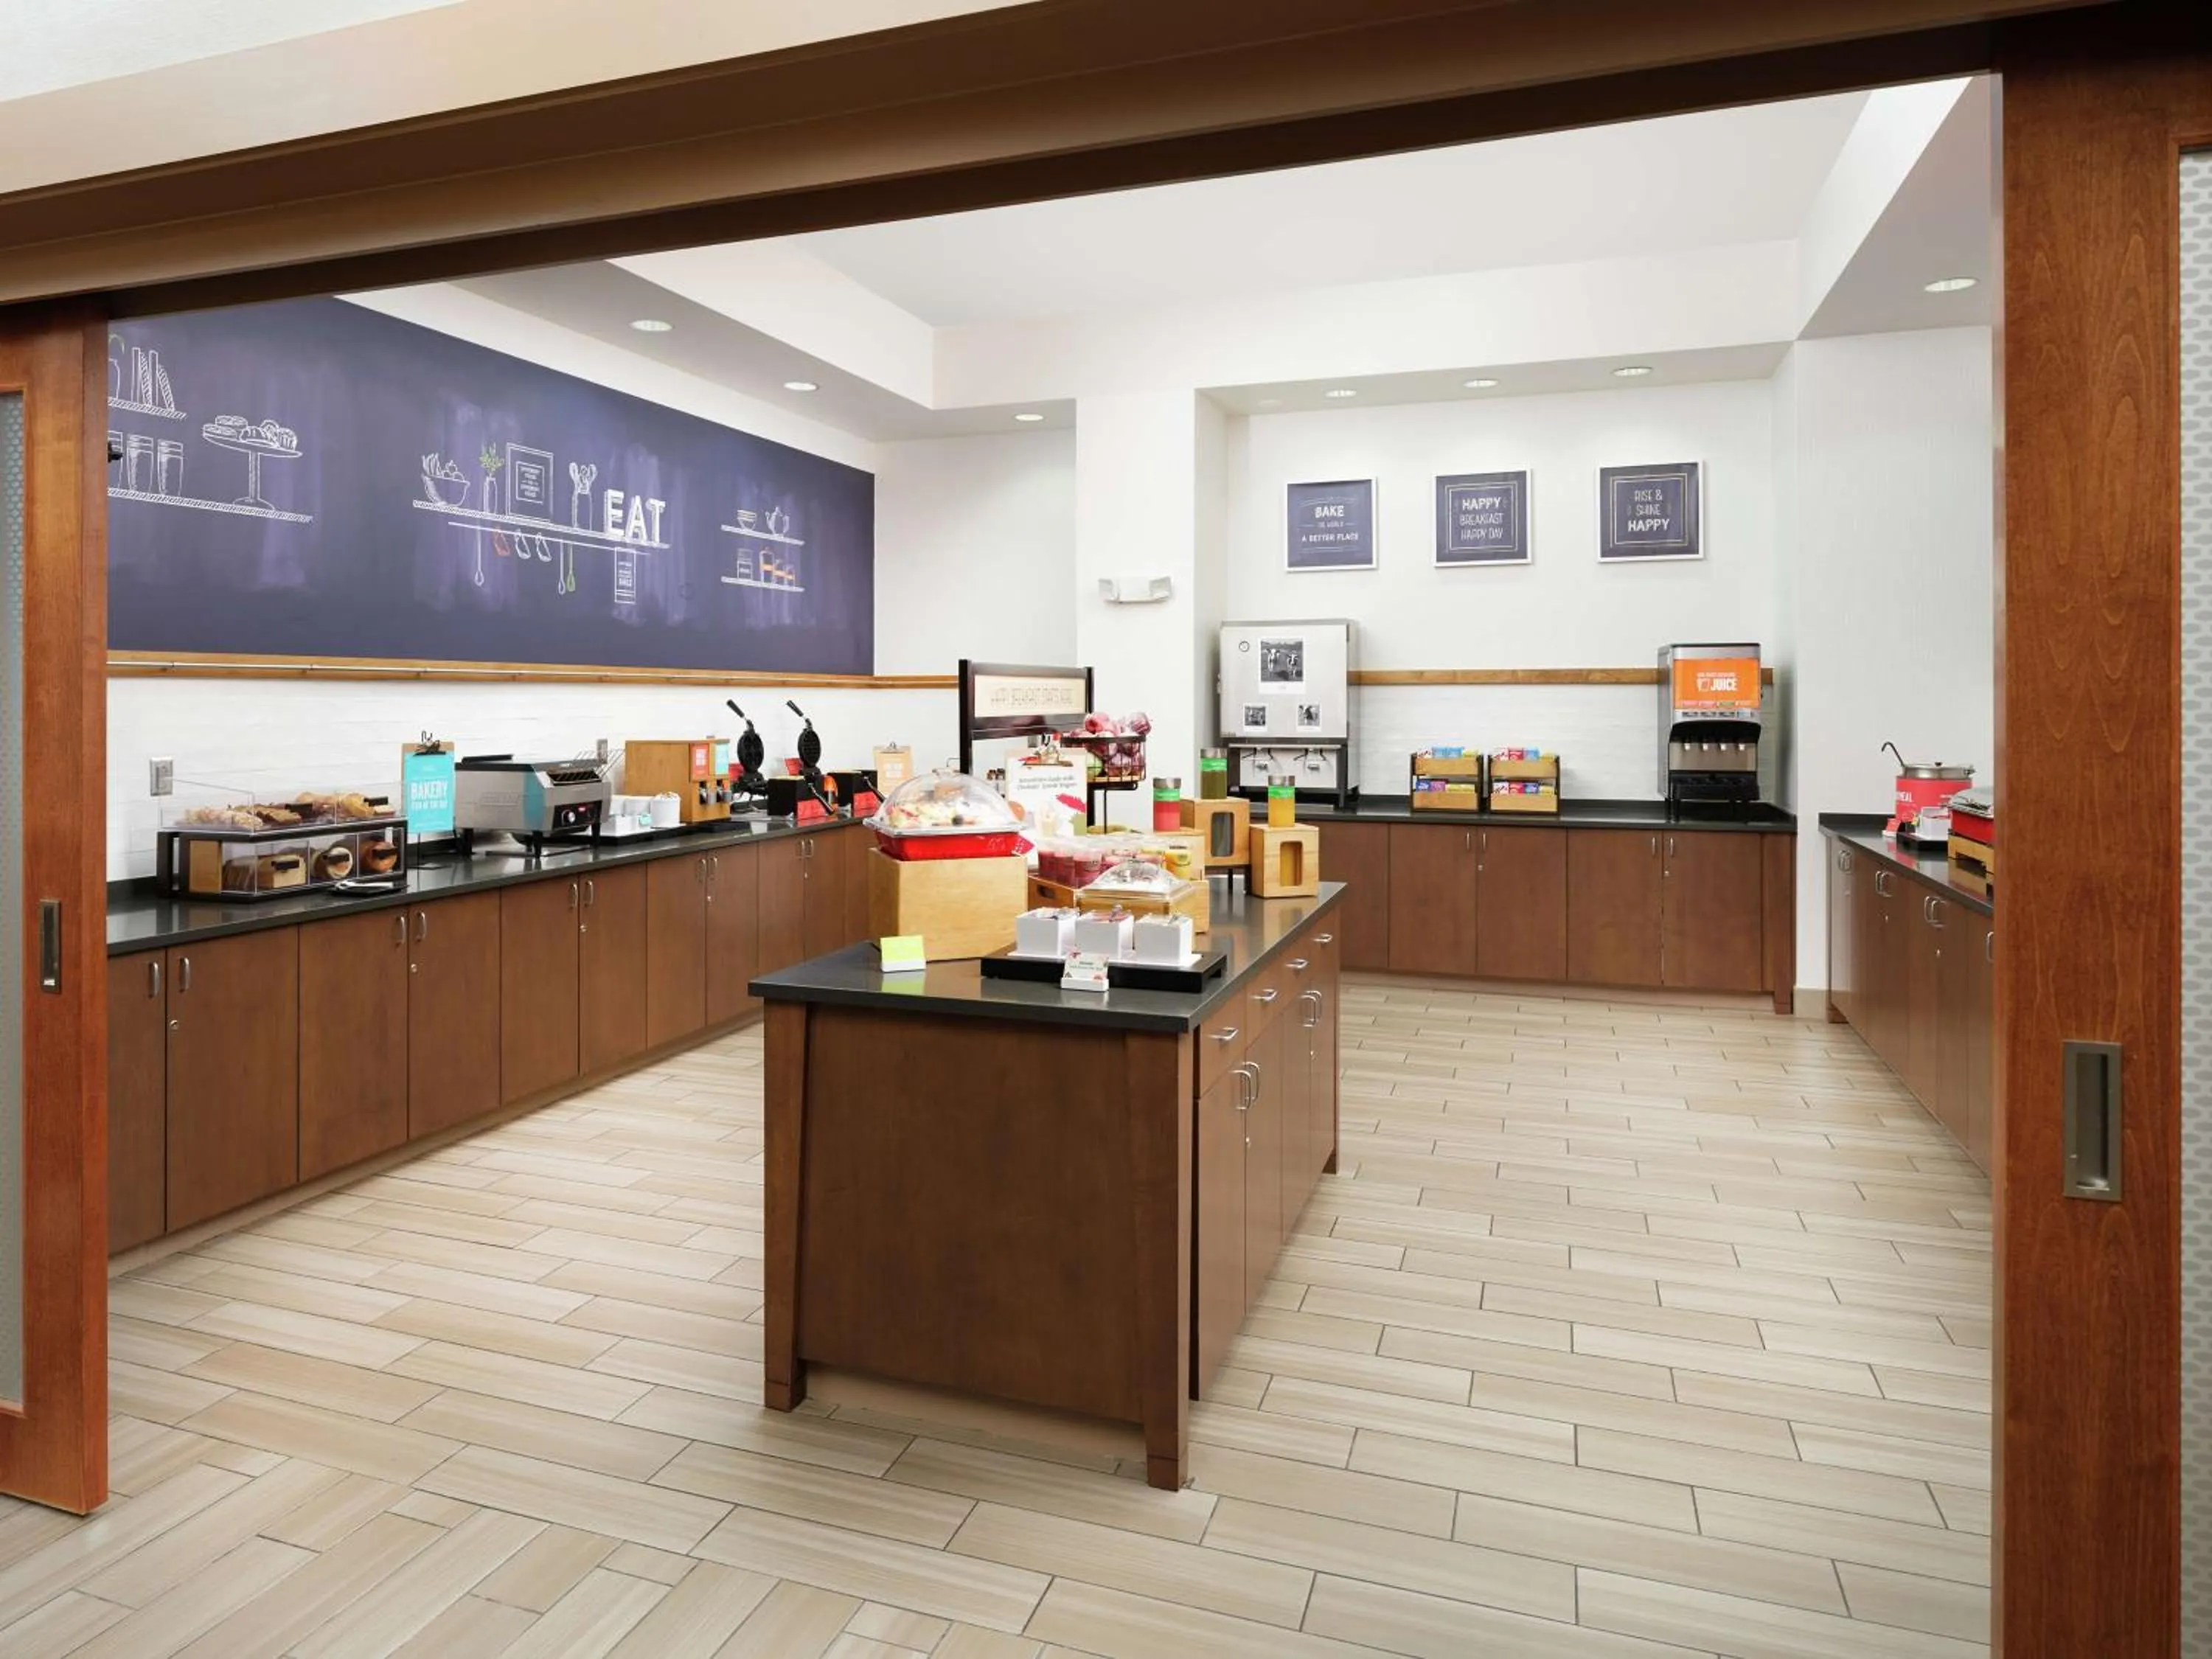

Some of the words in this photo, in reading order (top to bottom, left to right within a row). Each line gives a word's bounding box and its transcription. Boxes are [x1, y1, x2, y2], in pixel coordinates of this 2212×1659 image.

[1462, 496, 1501, 510] HAPPY
[605, 489, 666, 546] EAT
[1315, 505, 1344, 518] BAKE
[1627, 518, 1670, 532] HAPPY
[1711, 678, 1738, 691] JUICE
[411, 780, 448, 800] BAKERY
